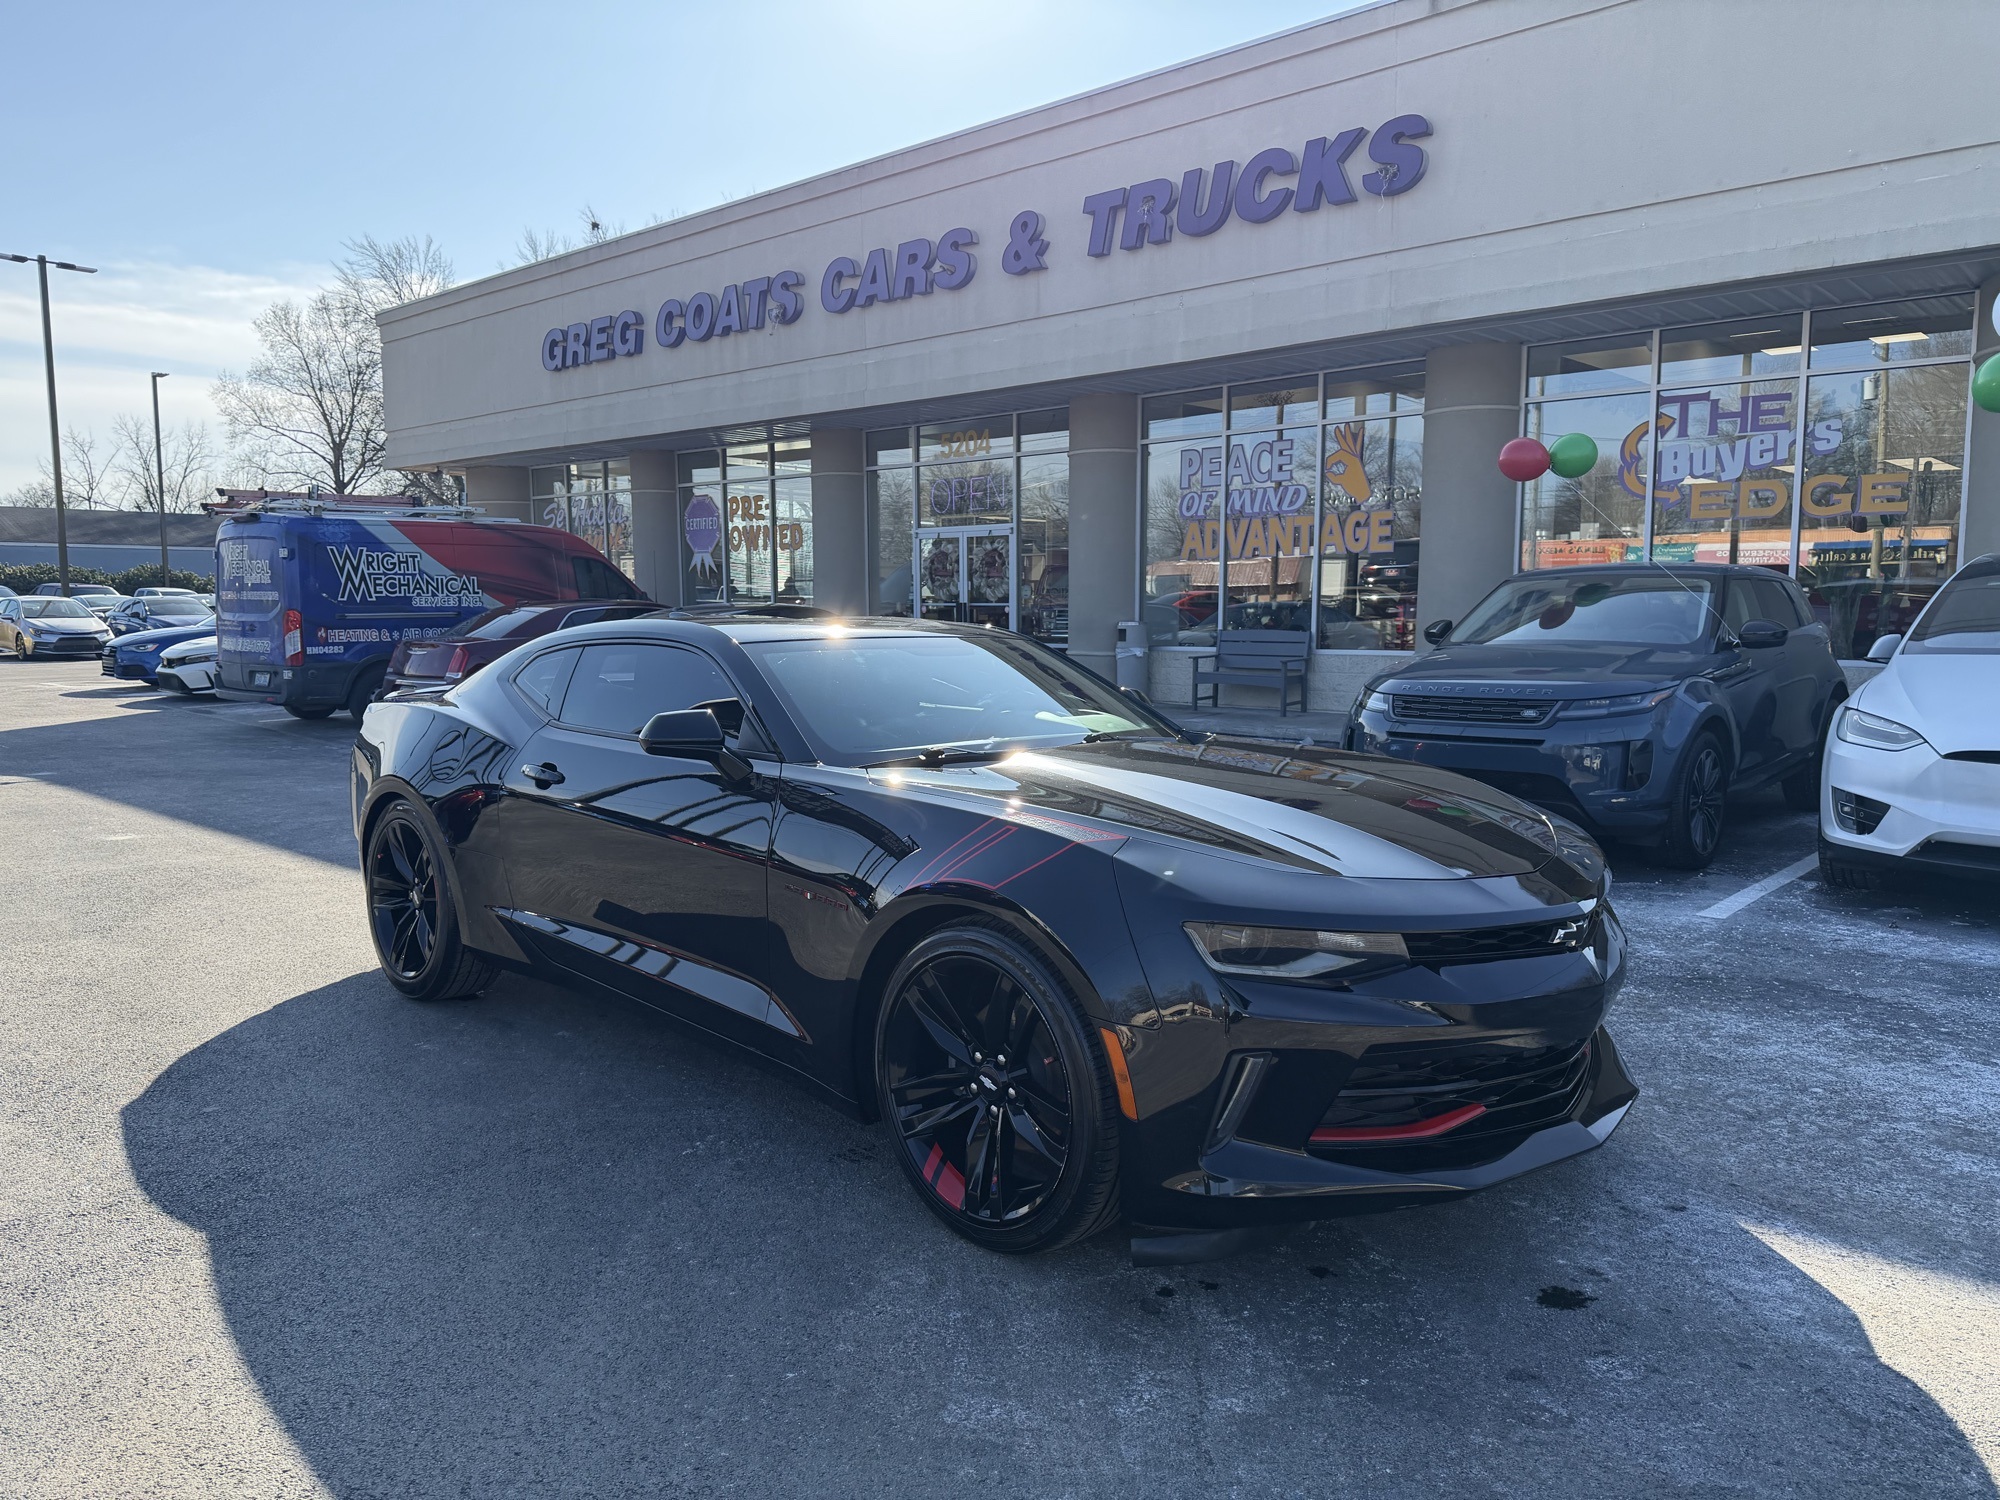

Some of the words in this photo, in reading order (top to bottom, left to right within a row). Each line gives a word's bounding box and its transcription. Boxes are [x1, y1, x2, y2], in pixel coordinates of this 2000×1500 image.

[541, 310, 645, 371] GREG
[656, 270, 805, 348] COATS
[821, 227, 979, 314] CARS
[1002, 210, 1050, 276] &
[1082, 113, 1434, 258] TRUCKS
[1658, 390, 1792, 439] THE
[940, 429, 992, 459] 5204
[1657, 418, 1844, 486] Buyer's
[1180, 438, 1294, 490] PEACE
[728, 494, 770, 523] PRE-
[930, 475, 1006, 514] OPEN
[1179, 490, 1217, 518] OF
[1226, 484, 1309, 516] MIND
[1686, 473, 1910, 521] EDGE
[543, 503, 565, 528] Se
[572, 495, 629, 527] Habla
[685, 516, 718, 531] CERTIFIED
[729, 524, 803, 552] OWNED
[1180, 510, 1394, 561] ADVANTAGE
[327, 544, 421, 577] WRIGHT
[337, 573, 482, 603] MECHANICAL
[412, 597, 458, 607] SERVICES
[461, 597, 483, 607] INC.
[327, 628, 379, 642] HEATING
[380, 628, 391, 641] &
[402, 628, 421, 640] AIR
[1401, 684, 1464, 693] RANGE
[1479, 686, 1553, 695] ROVER
